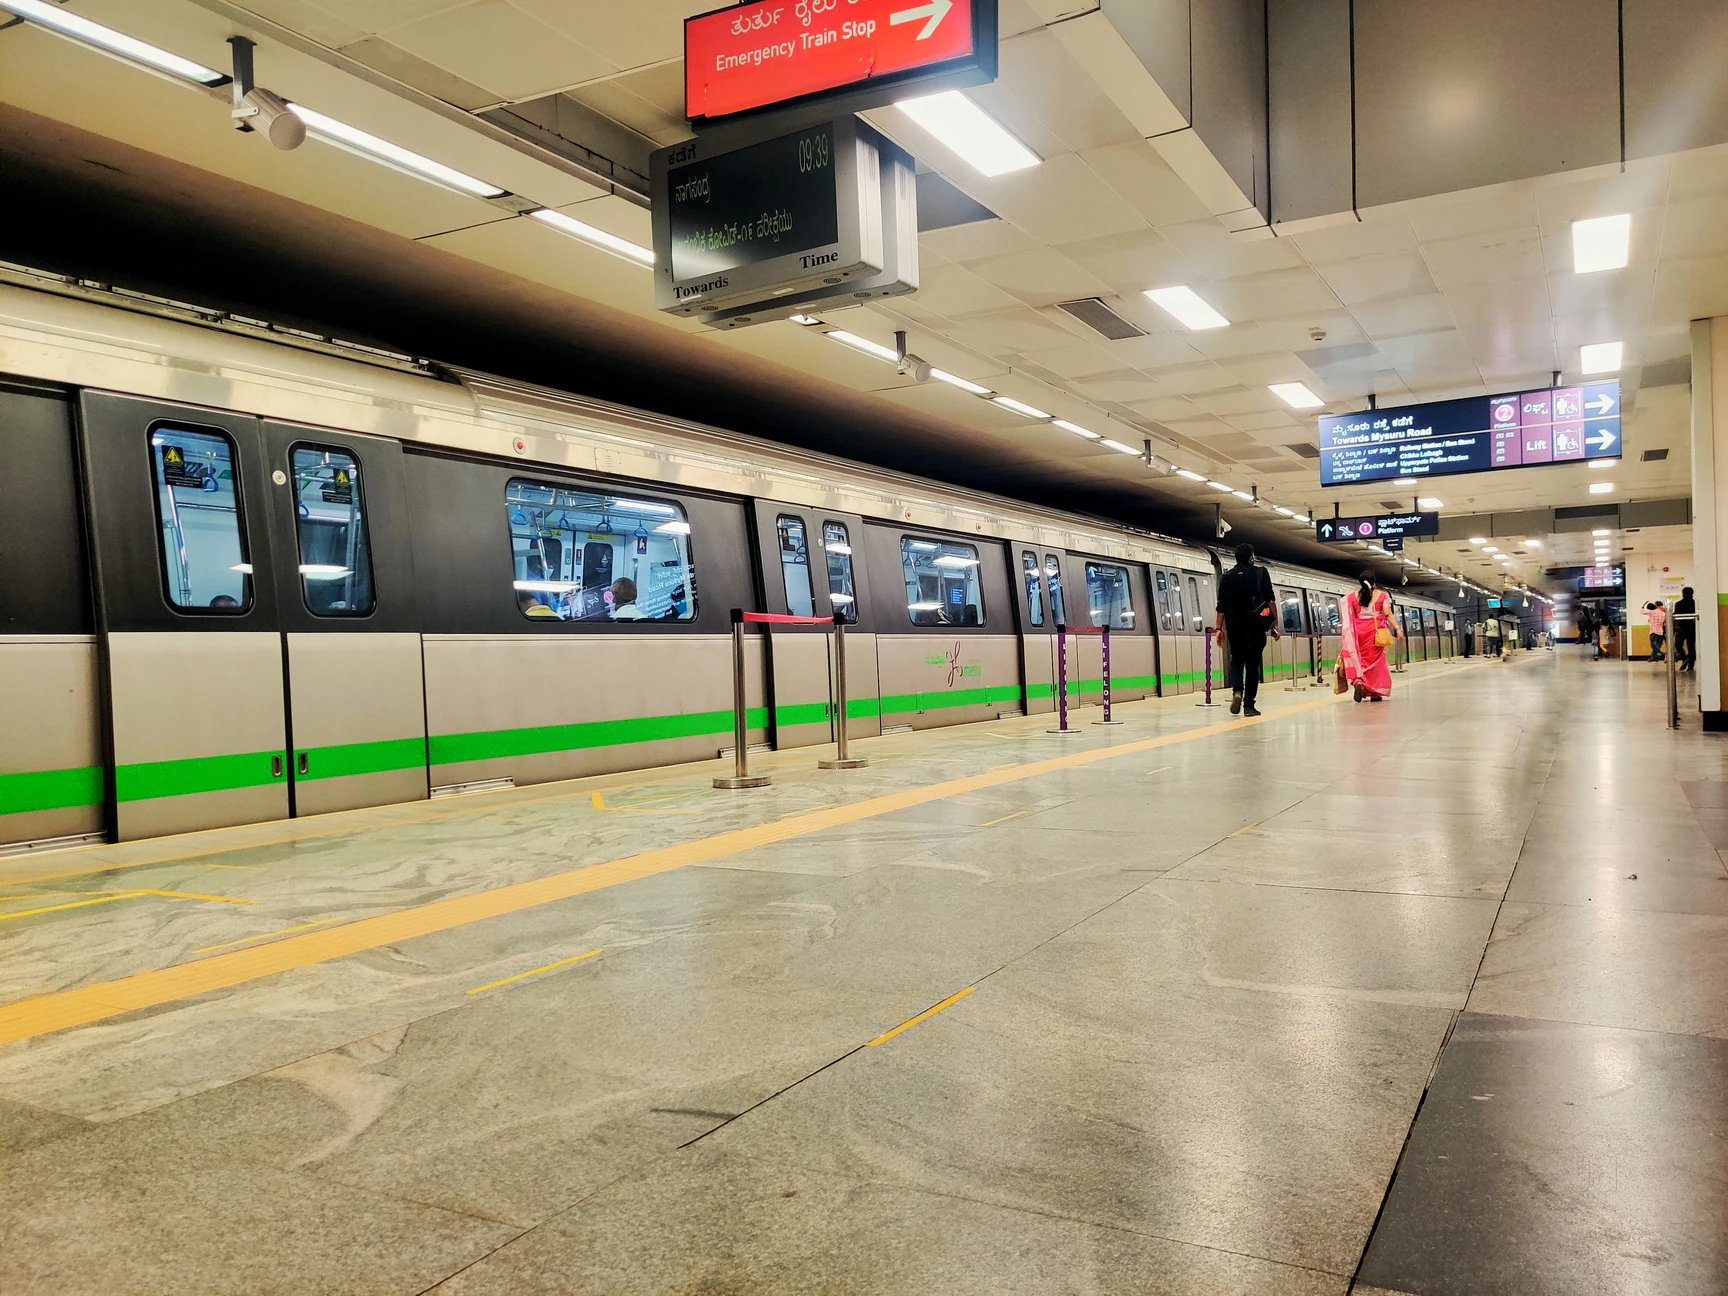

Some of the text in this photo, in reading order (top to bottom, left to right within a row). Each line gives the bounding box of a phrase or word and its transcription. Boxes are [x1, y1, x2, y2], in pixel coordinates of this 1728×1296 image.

[731, 8, 784, 35] ತುರ್ತು
[716, 19, 876, 71] Emergency Train Stop
[667, 143, 697, 166] ಕಡೆಗೆ
[799, 133, 829, 173] 09:39
[800, 251, 839, 269] Time
[673, 275, 729, 299] Towards
[1332, 426, 1432, 445] Towards Mysuru Road
[1526, 440, 1547, 451] Lift
[1378, 527, 1404, 535] Platform
